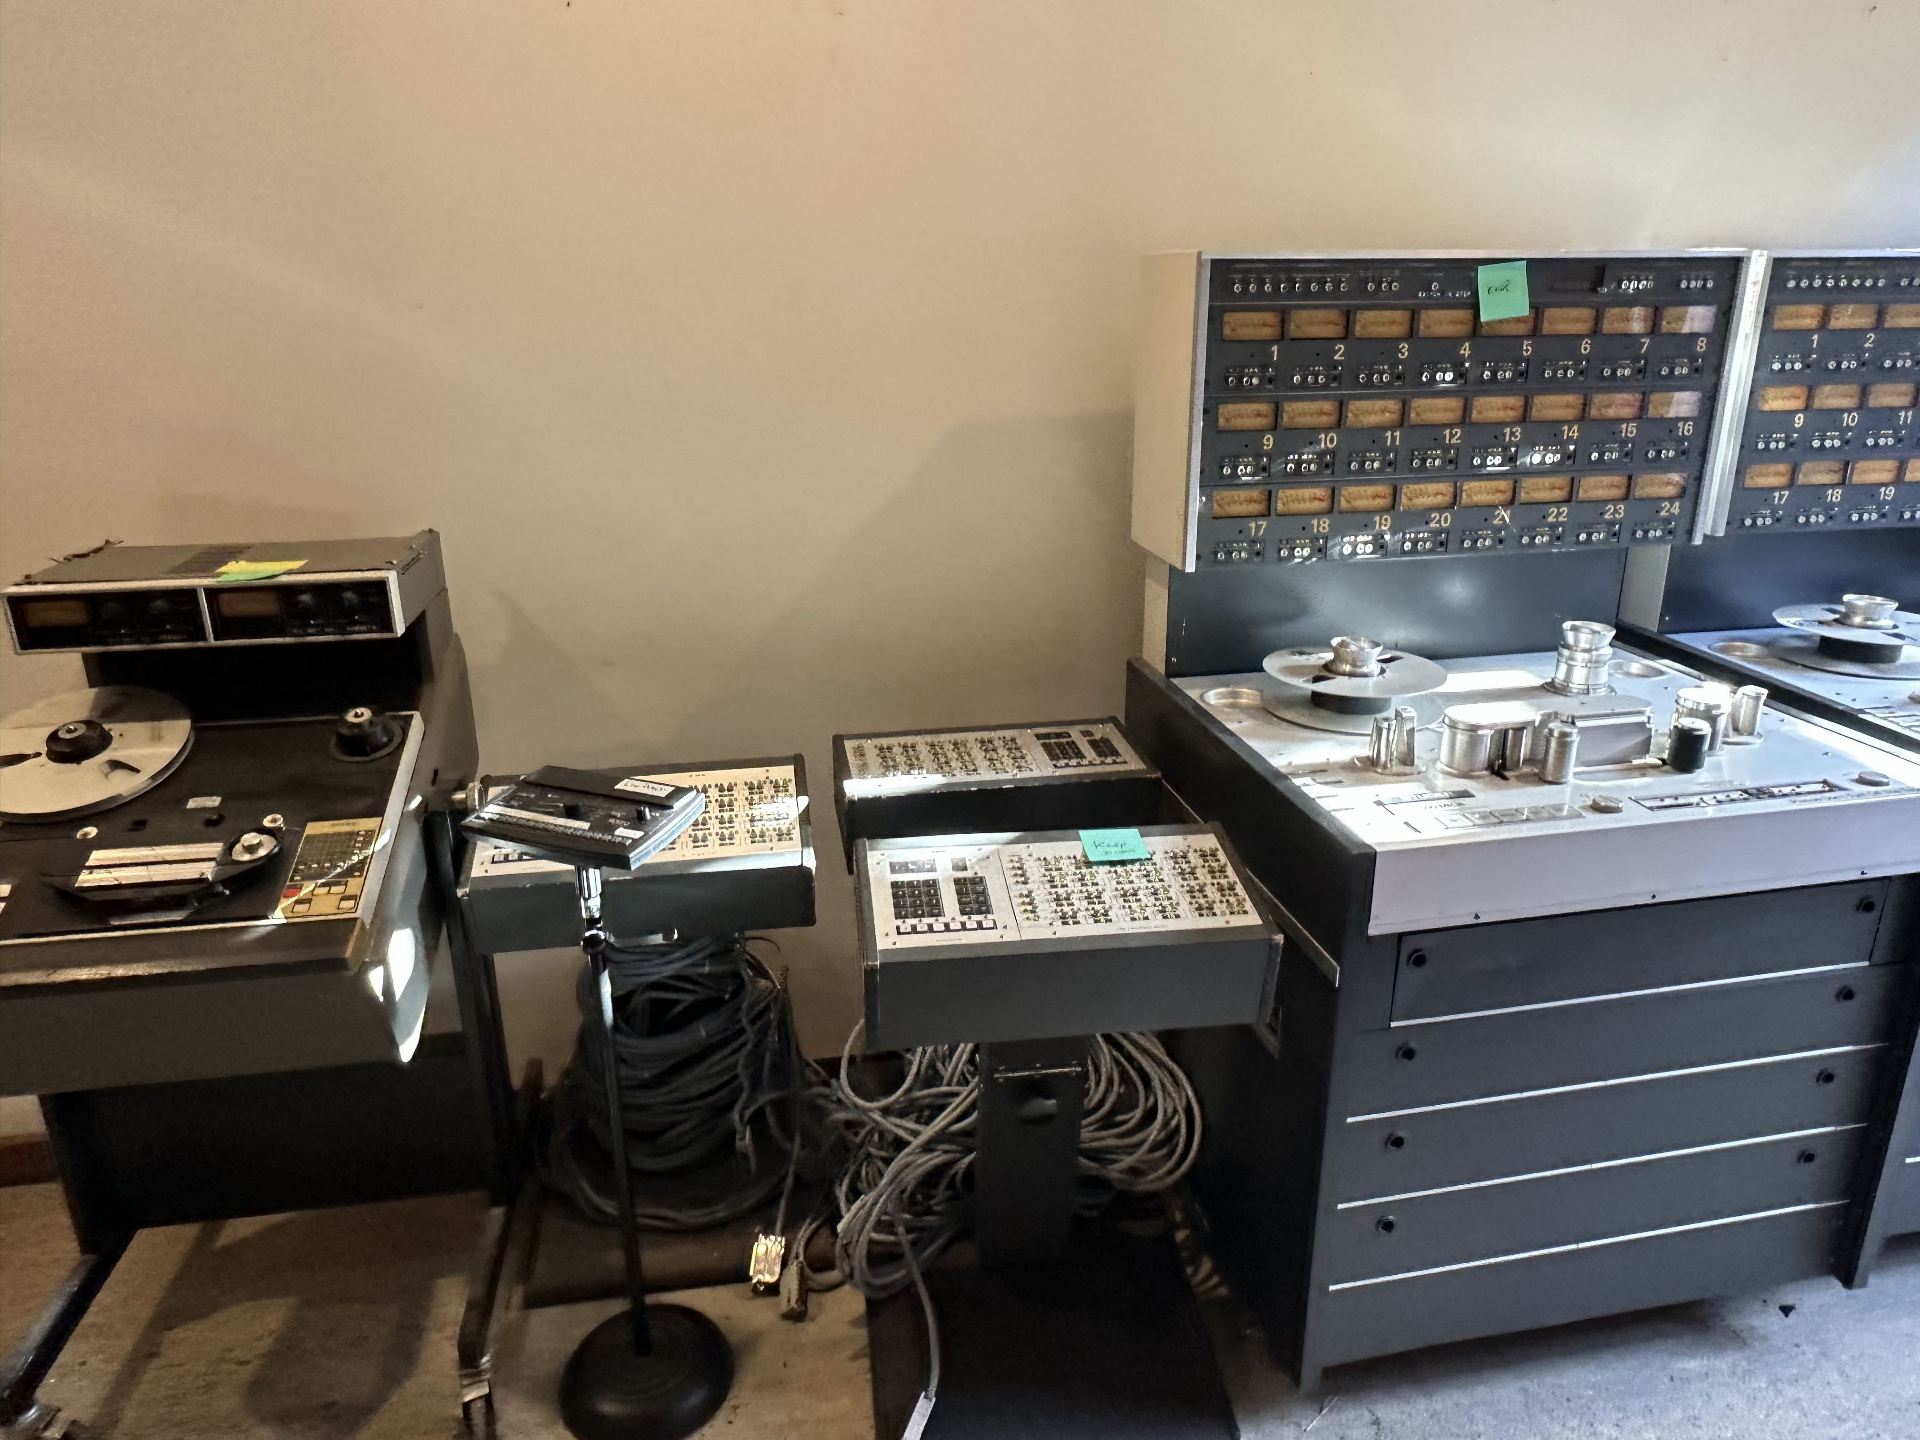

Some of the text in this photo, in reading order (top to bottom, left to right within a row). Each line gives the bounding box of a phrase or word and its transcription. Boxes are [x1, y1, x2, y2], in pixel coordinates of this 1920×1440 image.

[1522, 340, 1532, 356] 5
[1581, 339, 1591, 354] 6
[1640, 338, 1650, 354] 7
[1696, 338, 1707, 352] 8
[1812, 334, 1818, 348] 1
[1864, 333, 1874, 348] 2
[1271, 344, 1278, 360] 1
[1334, 344, 1344, 360] 2
[1398, 342, 1408, 359] 3
[1460, 342, 1471, 358] 4
[1794, 413, 1804, 428] 9
[1842, 412, 1858, 427] 10
[1899, 410, 1912, 425] 11
[1443, 428, 1461, 444] 12
[1504, 427, 1521, 442] 13
[1562, 425, 1579, 440] 14
[1621, 423, 1637, 438] 15
[1678, 422, 1694, 436] 16
[1263, 434, 1274, 450] 9
[1318, 433, 1338, 449] 10
[1385, 431, 1400, 446] 11
[1773, 490, 1790, 504] 17
[1826, 488, 1842, 503] 18
[1879, 486, 1895, 500] 19
[1548, 508, 1568, 522] 22
[1604, 505, 1625, 519] 23
[1660, 502, 1680, 516] 24
[1373, 515, 1392, 530] 19
[1430, 512, 1451, 528] 20
[1493, 510, 1511, 525] 21
[1249, 521, 1268, 536] 17
[1311, 518, 1330, 534] 18
